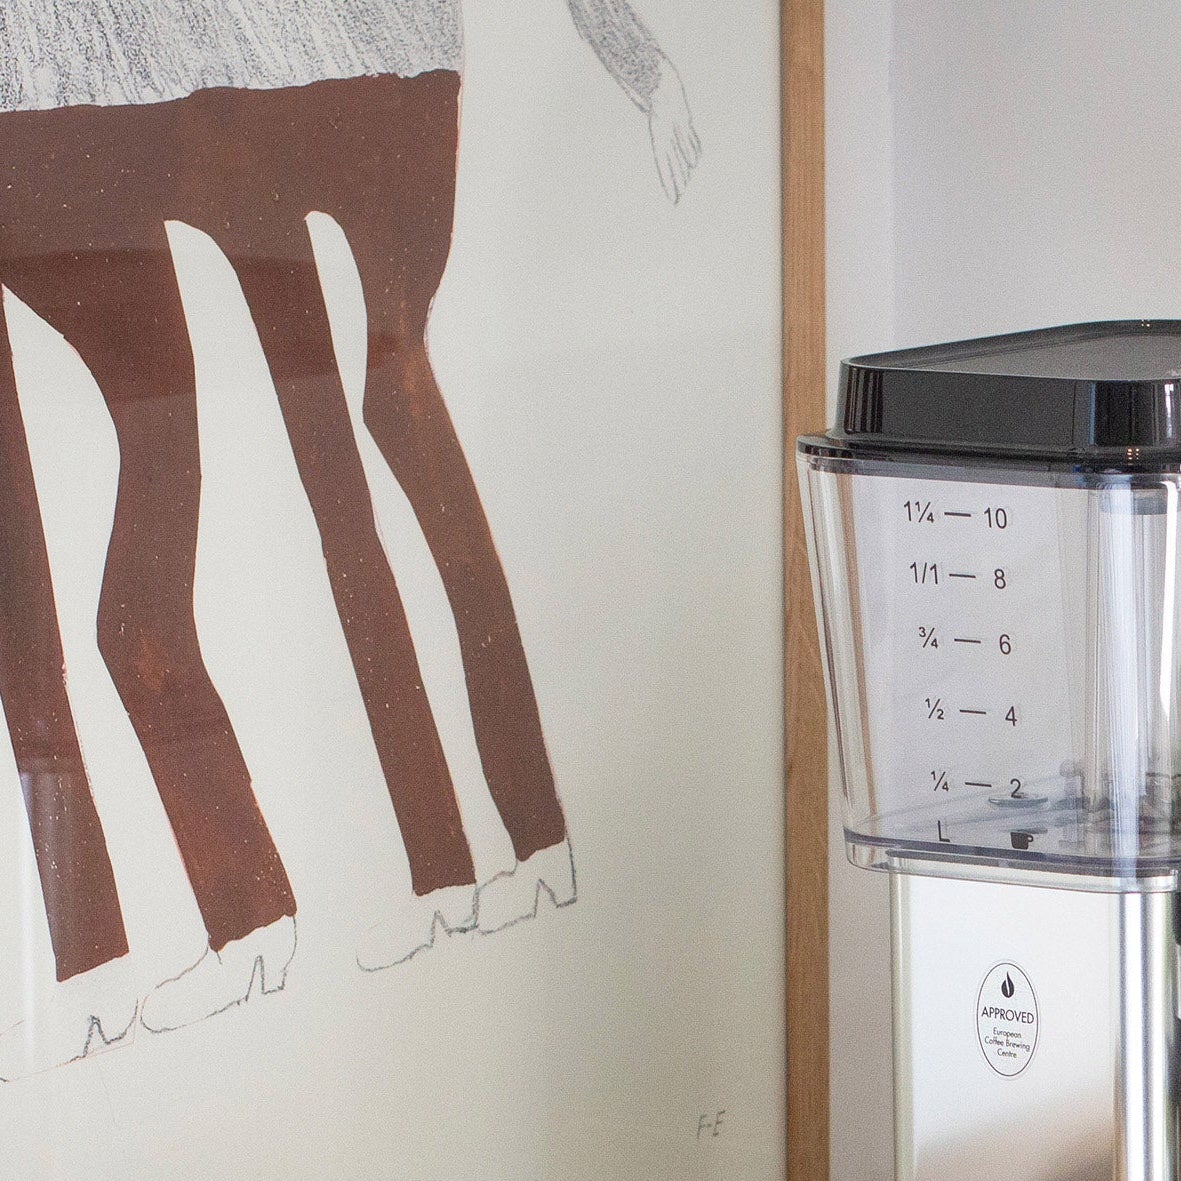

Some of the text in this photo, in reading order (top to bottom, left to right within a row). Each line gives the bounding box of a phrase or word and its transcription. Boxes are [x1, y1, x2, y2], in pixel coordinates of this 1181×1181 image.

[984, 507, 1007, 529] 10
[910, 562, 1006, 589] 1/1 8
[999, 634, 1011, 655] 6
[1005, 706, 1017, 727] 4
[1010, 778, 1022, 799] 2
[938, 820, 950, 843] L
[981, 1006, 1035, 1024] APPROVED
[984, 1035, 1030, 1052] Coffee Brewing
[993, 1026, 1022, 1040] European
[997, 1048, 1018, 1058] Centre
